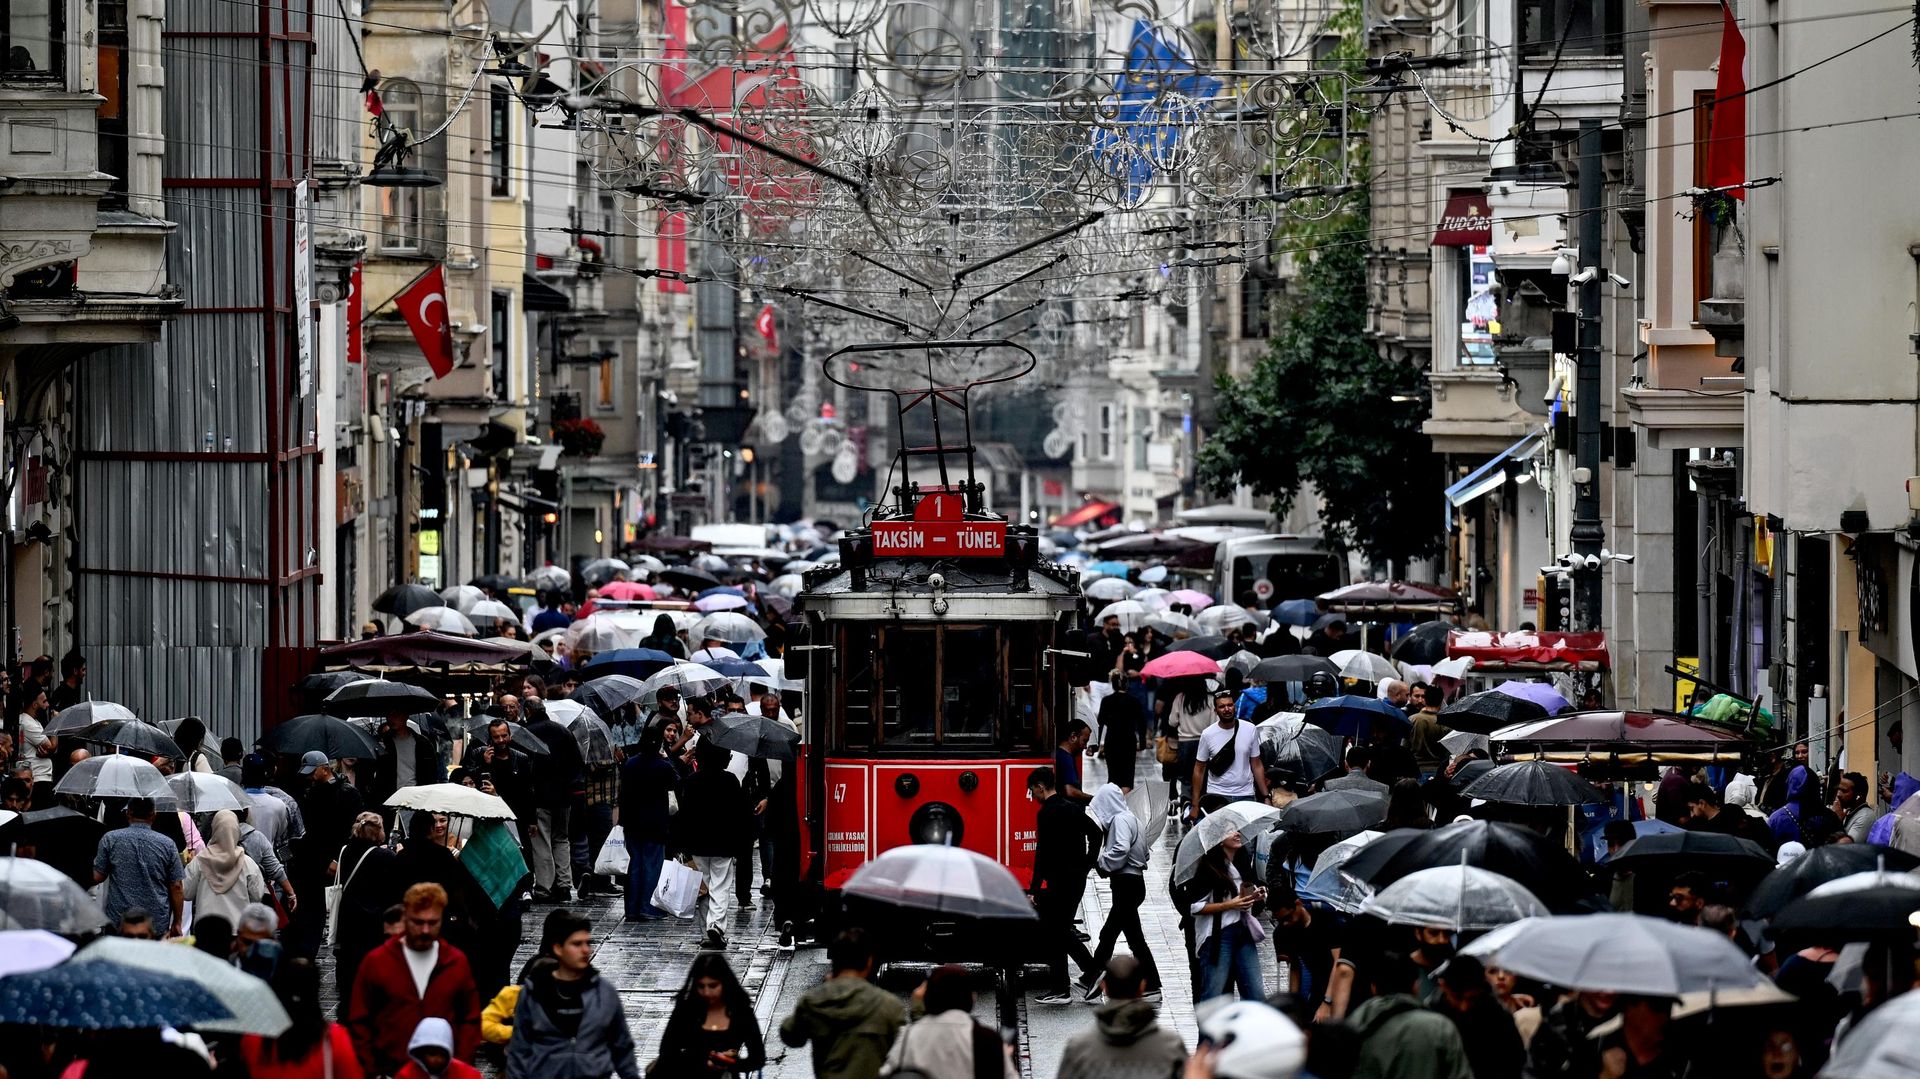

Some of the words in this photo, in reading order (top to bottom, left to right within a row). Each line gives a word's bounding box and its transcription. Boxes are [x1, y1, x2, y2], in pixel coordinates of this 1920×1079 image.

[1443, 215, 1491, 231] TUDORS
[934, 495, 942, 518] 1
[874, 526, 924, 549] TAKSİM
[956, 526, 1002, 549] TÜNEL
[834, 783, 847, 803] 47
[845, 831, 866, 841] YASAK
